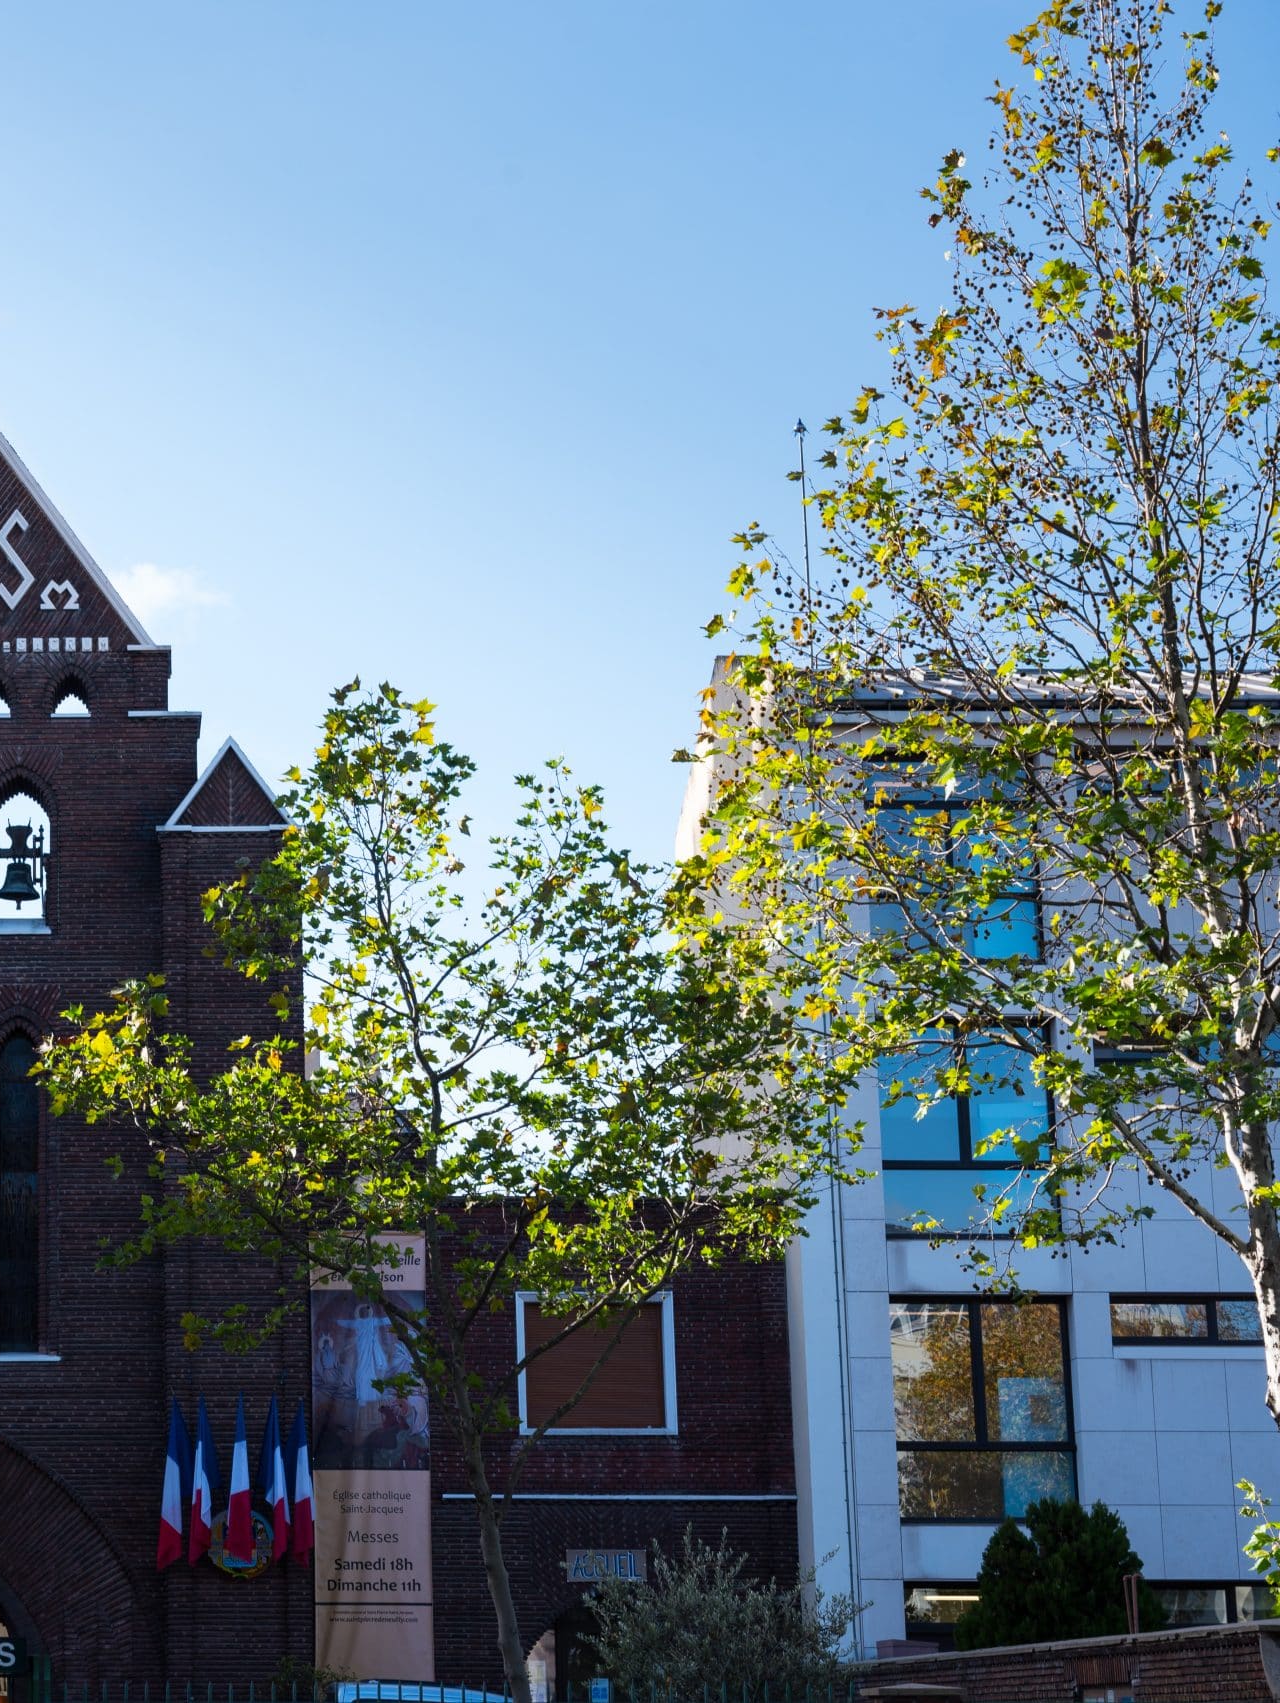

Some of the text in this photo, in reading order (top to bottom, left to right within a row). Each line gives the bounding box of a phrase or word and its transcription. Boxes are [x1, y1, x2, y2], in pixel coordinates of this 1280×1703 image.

[333, 1489, 411, 1501] Église catholique
[340, 1504, 404, 1515] Saint-Jacques
[347, 1530, 400, 1543] Messes
[334, 1557, 413, 1571] Samedi 18h
[572, 1551, 642, 1579] ACCUEIL
[327, 1578, 421, 1592] Dimanche 11h
